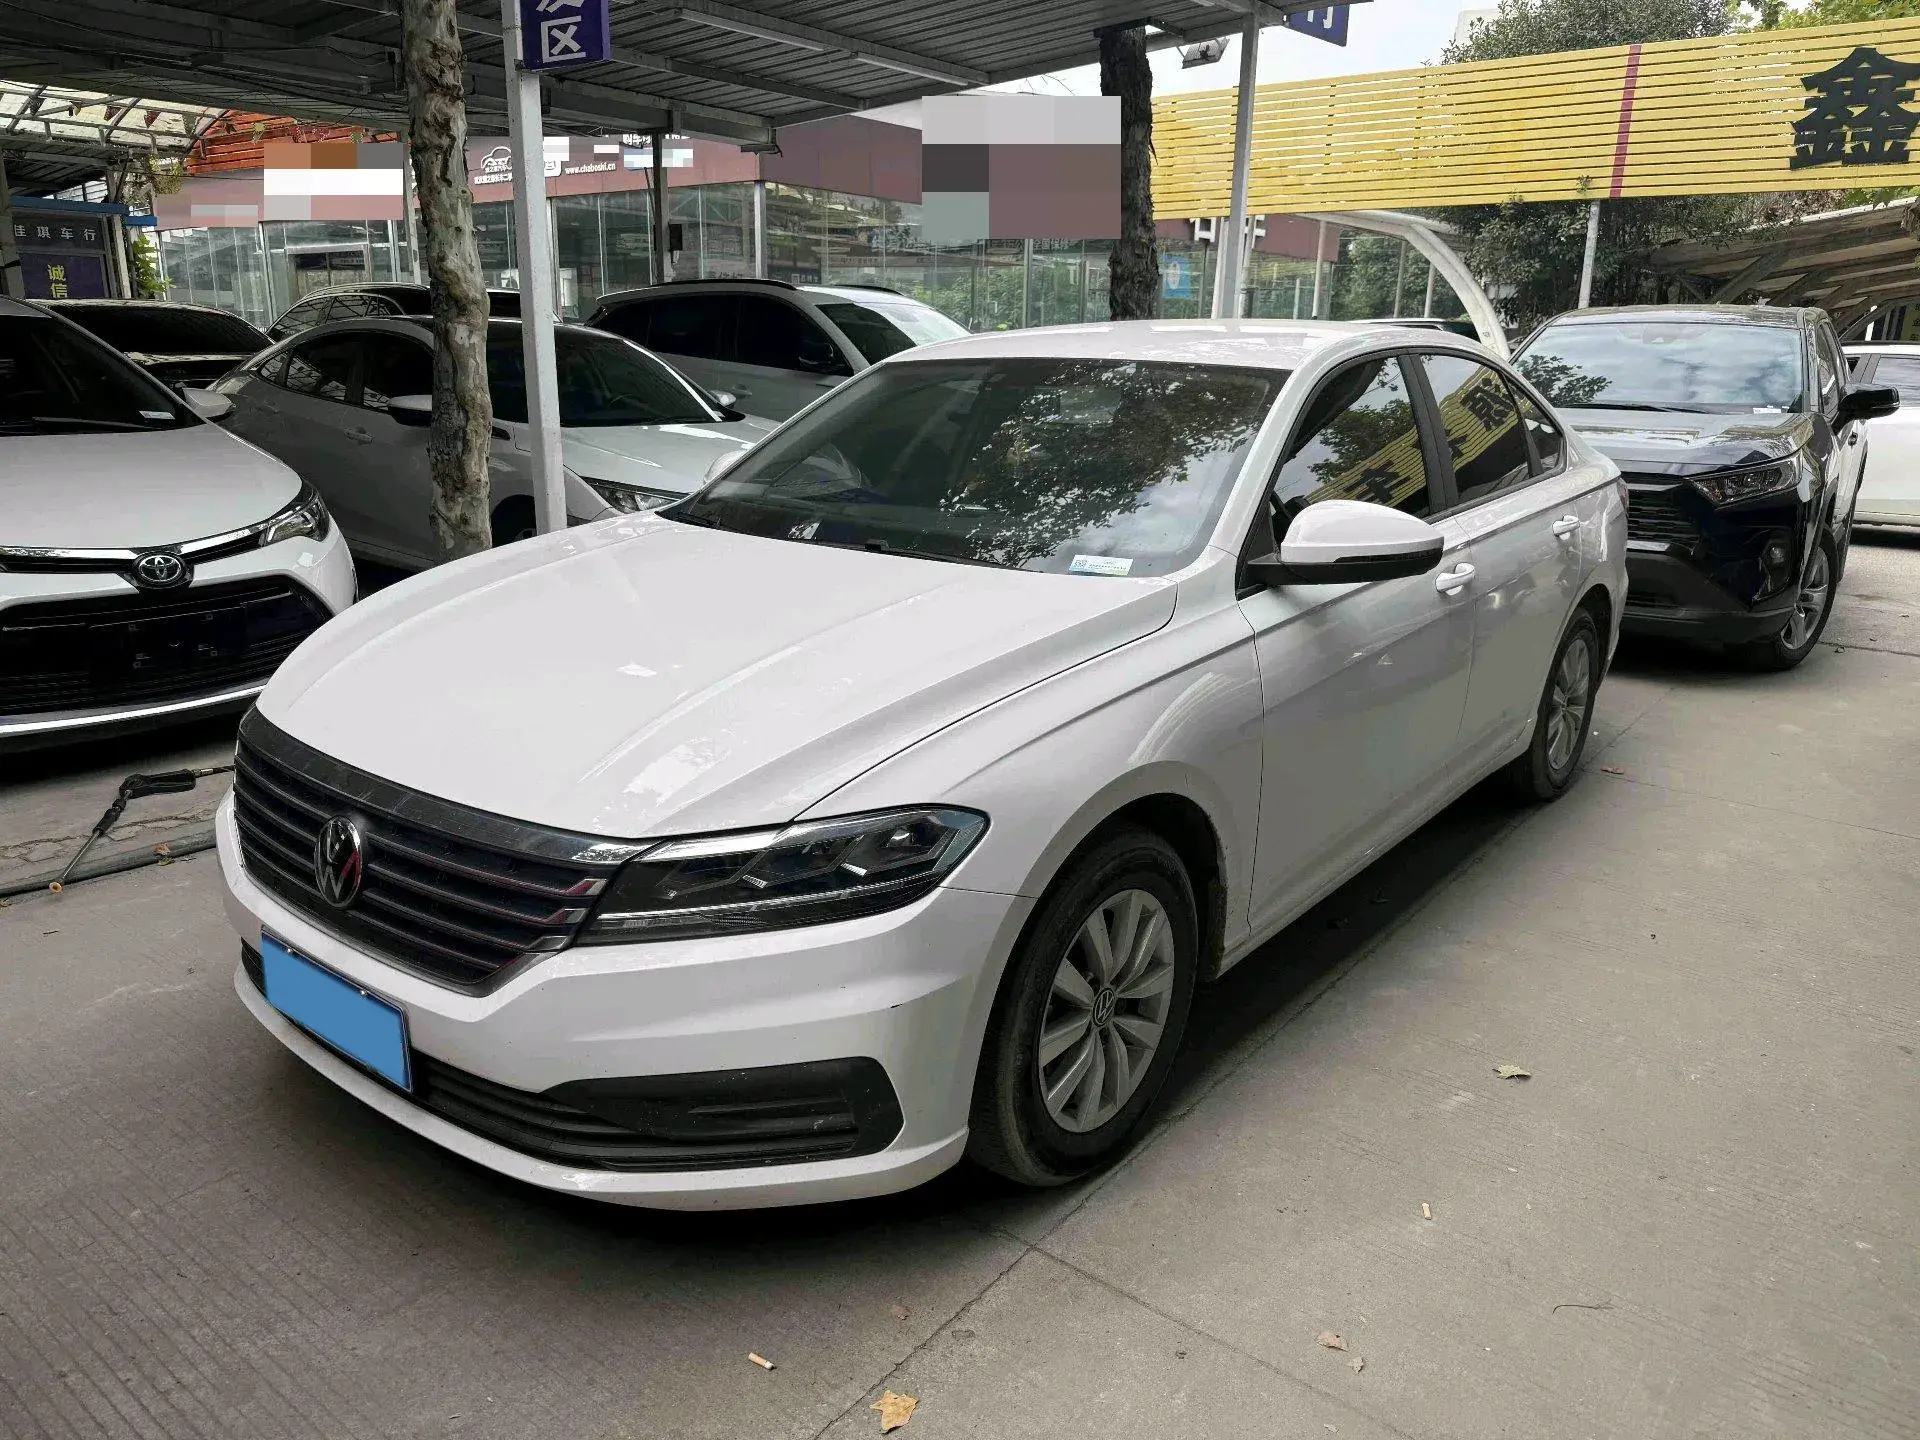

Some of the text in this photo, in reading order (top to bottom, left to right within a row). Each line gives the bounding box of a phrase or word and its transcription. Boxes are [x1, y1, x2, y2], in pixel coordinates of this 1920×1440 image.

[536, 0, 586, 63] 区
[1789, 47, 1920, 170] 鑫
[564, 161, 616, 175] www.chaboshi.cn
